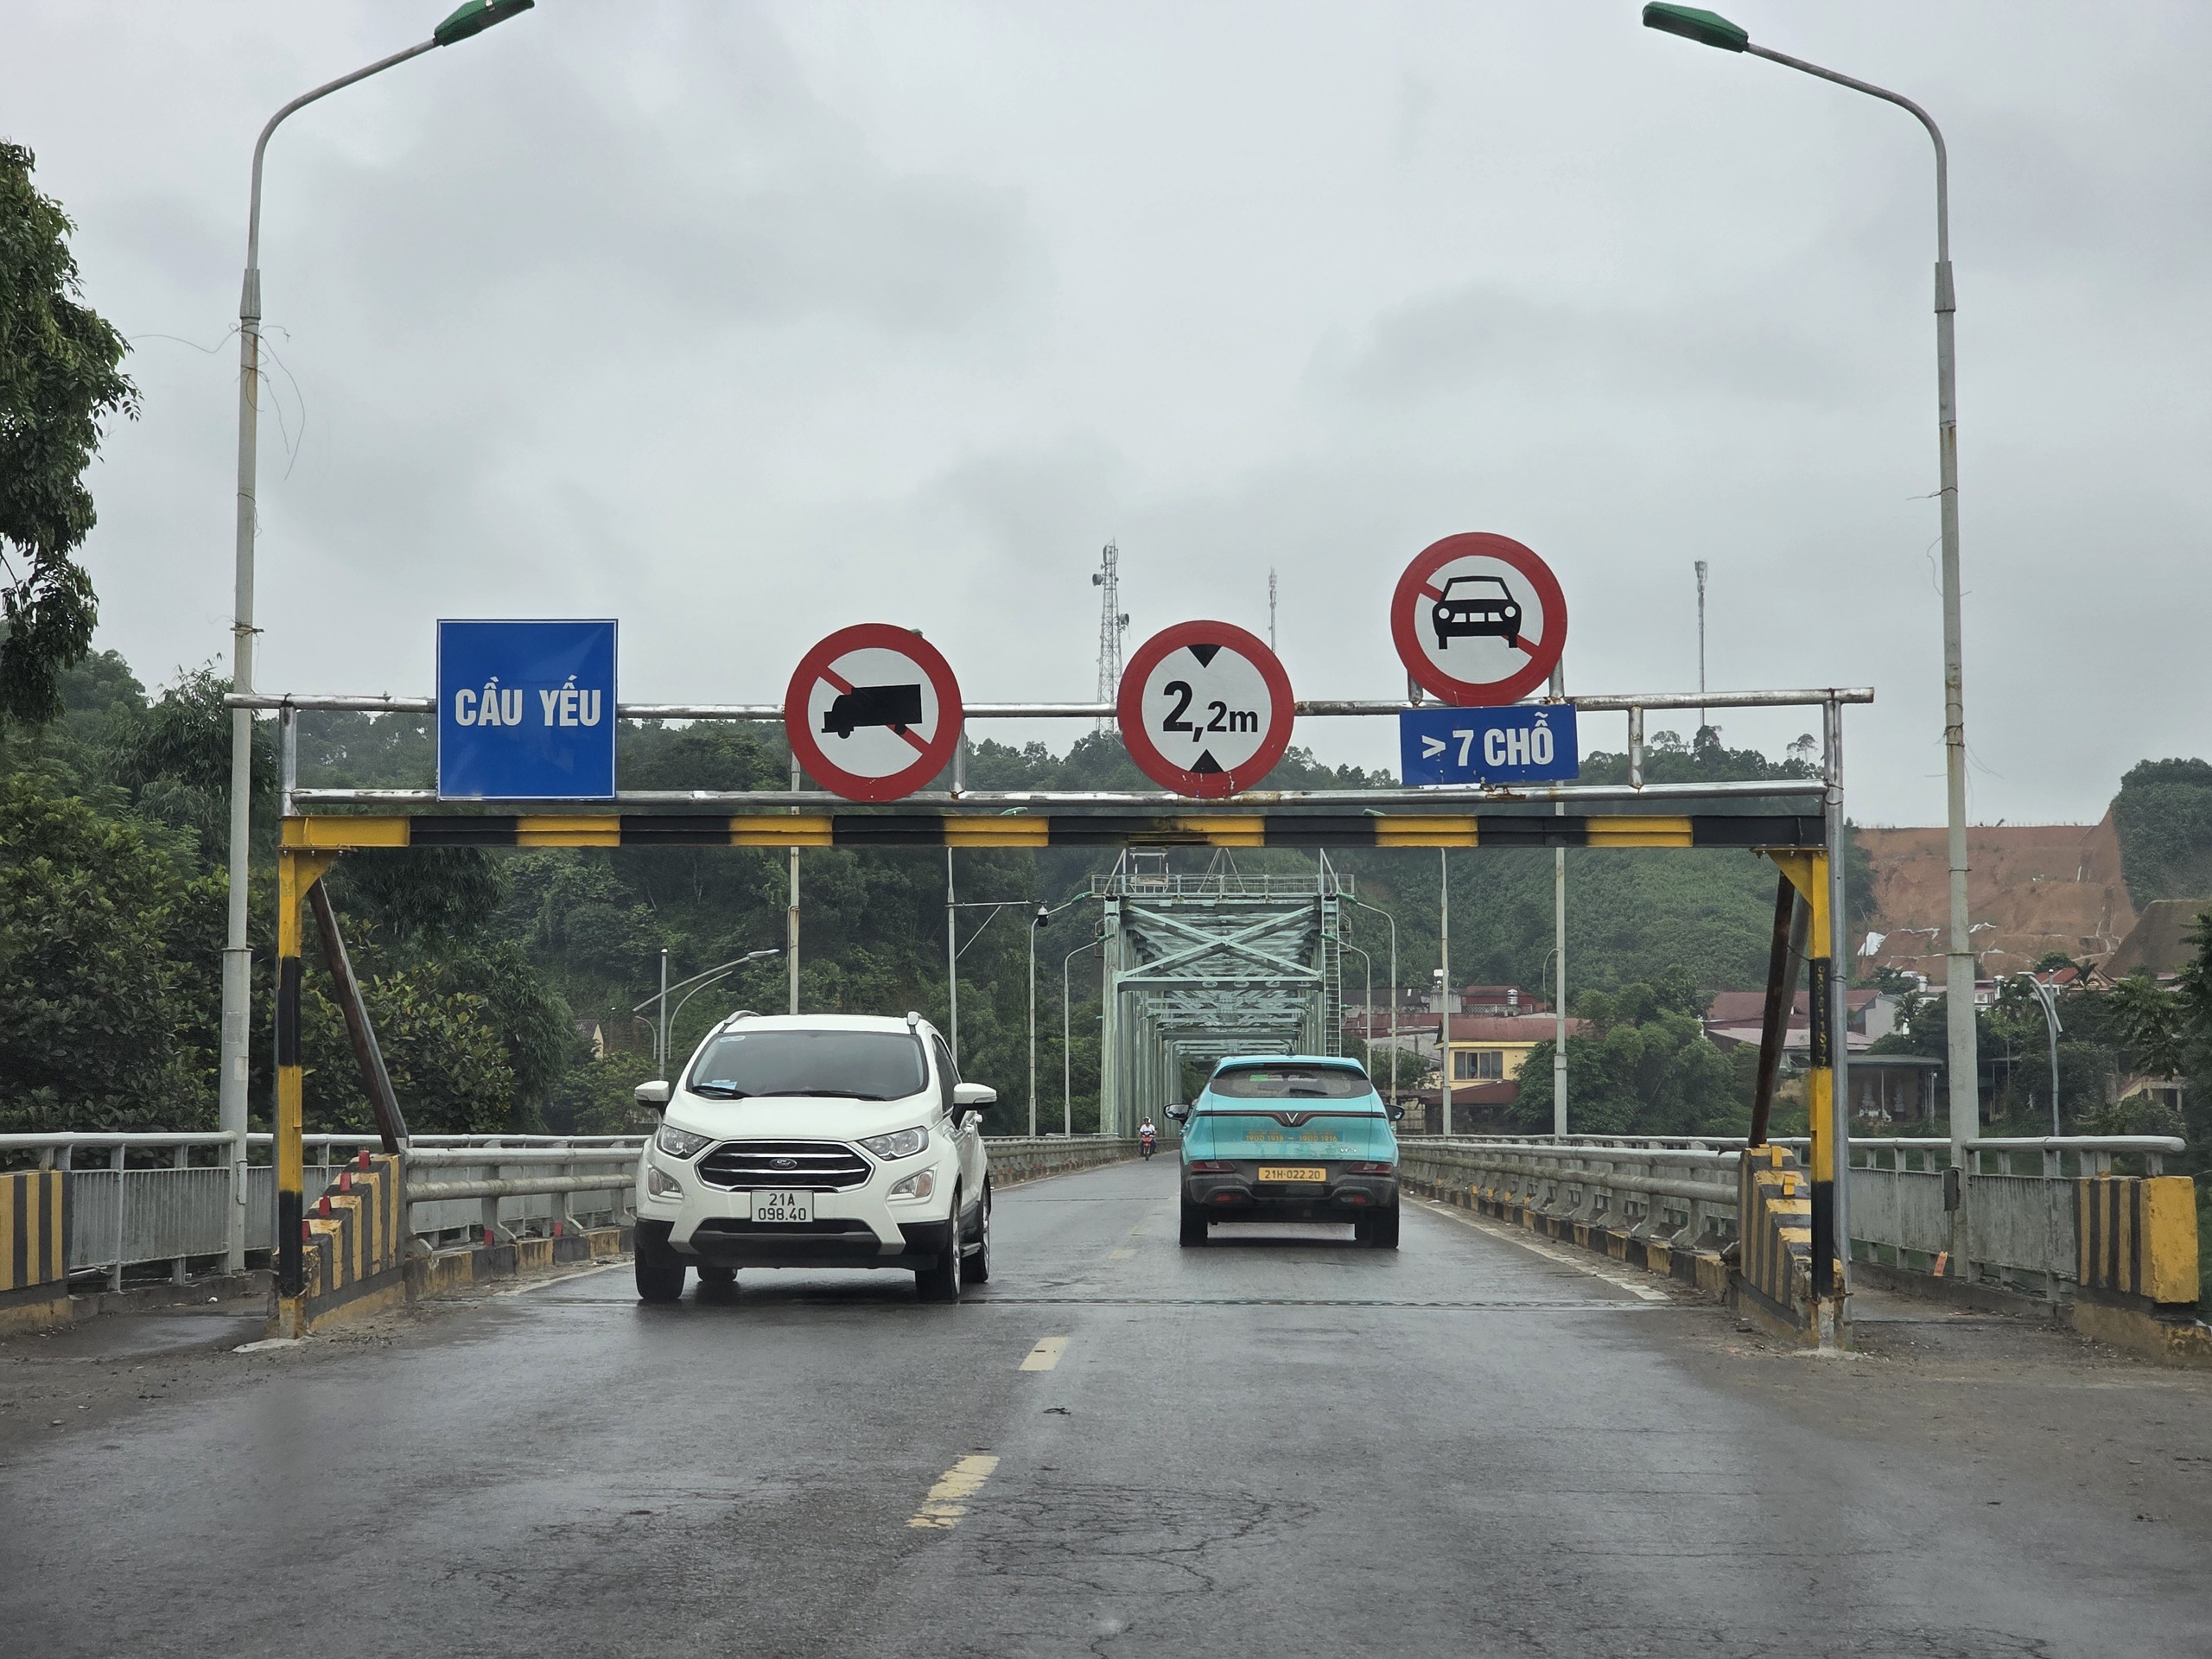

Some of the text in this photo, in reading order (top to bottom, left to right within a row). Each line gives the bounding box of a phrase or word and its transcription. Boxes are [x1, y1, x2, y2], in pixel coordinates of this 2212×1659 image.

[455, 674, 601, 727] CẦU YẾU
[1162, 680, 1258, 742] 2,2m
[1421, 711, 1554, 766] > 7 CHỖ
[759, 1208, 806, 1220] 098.40
[769, 1193, 795, 1206] 21A
